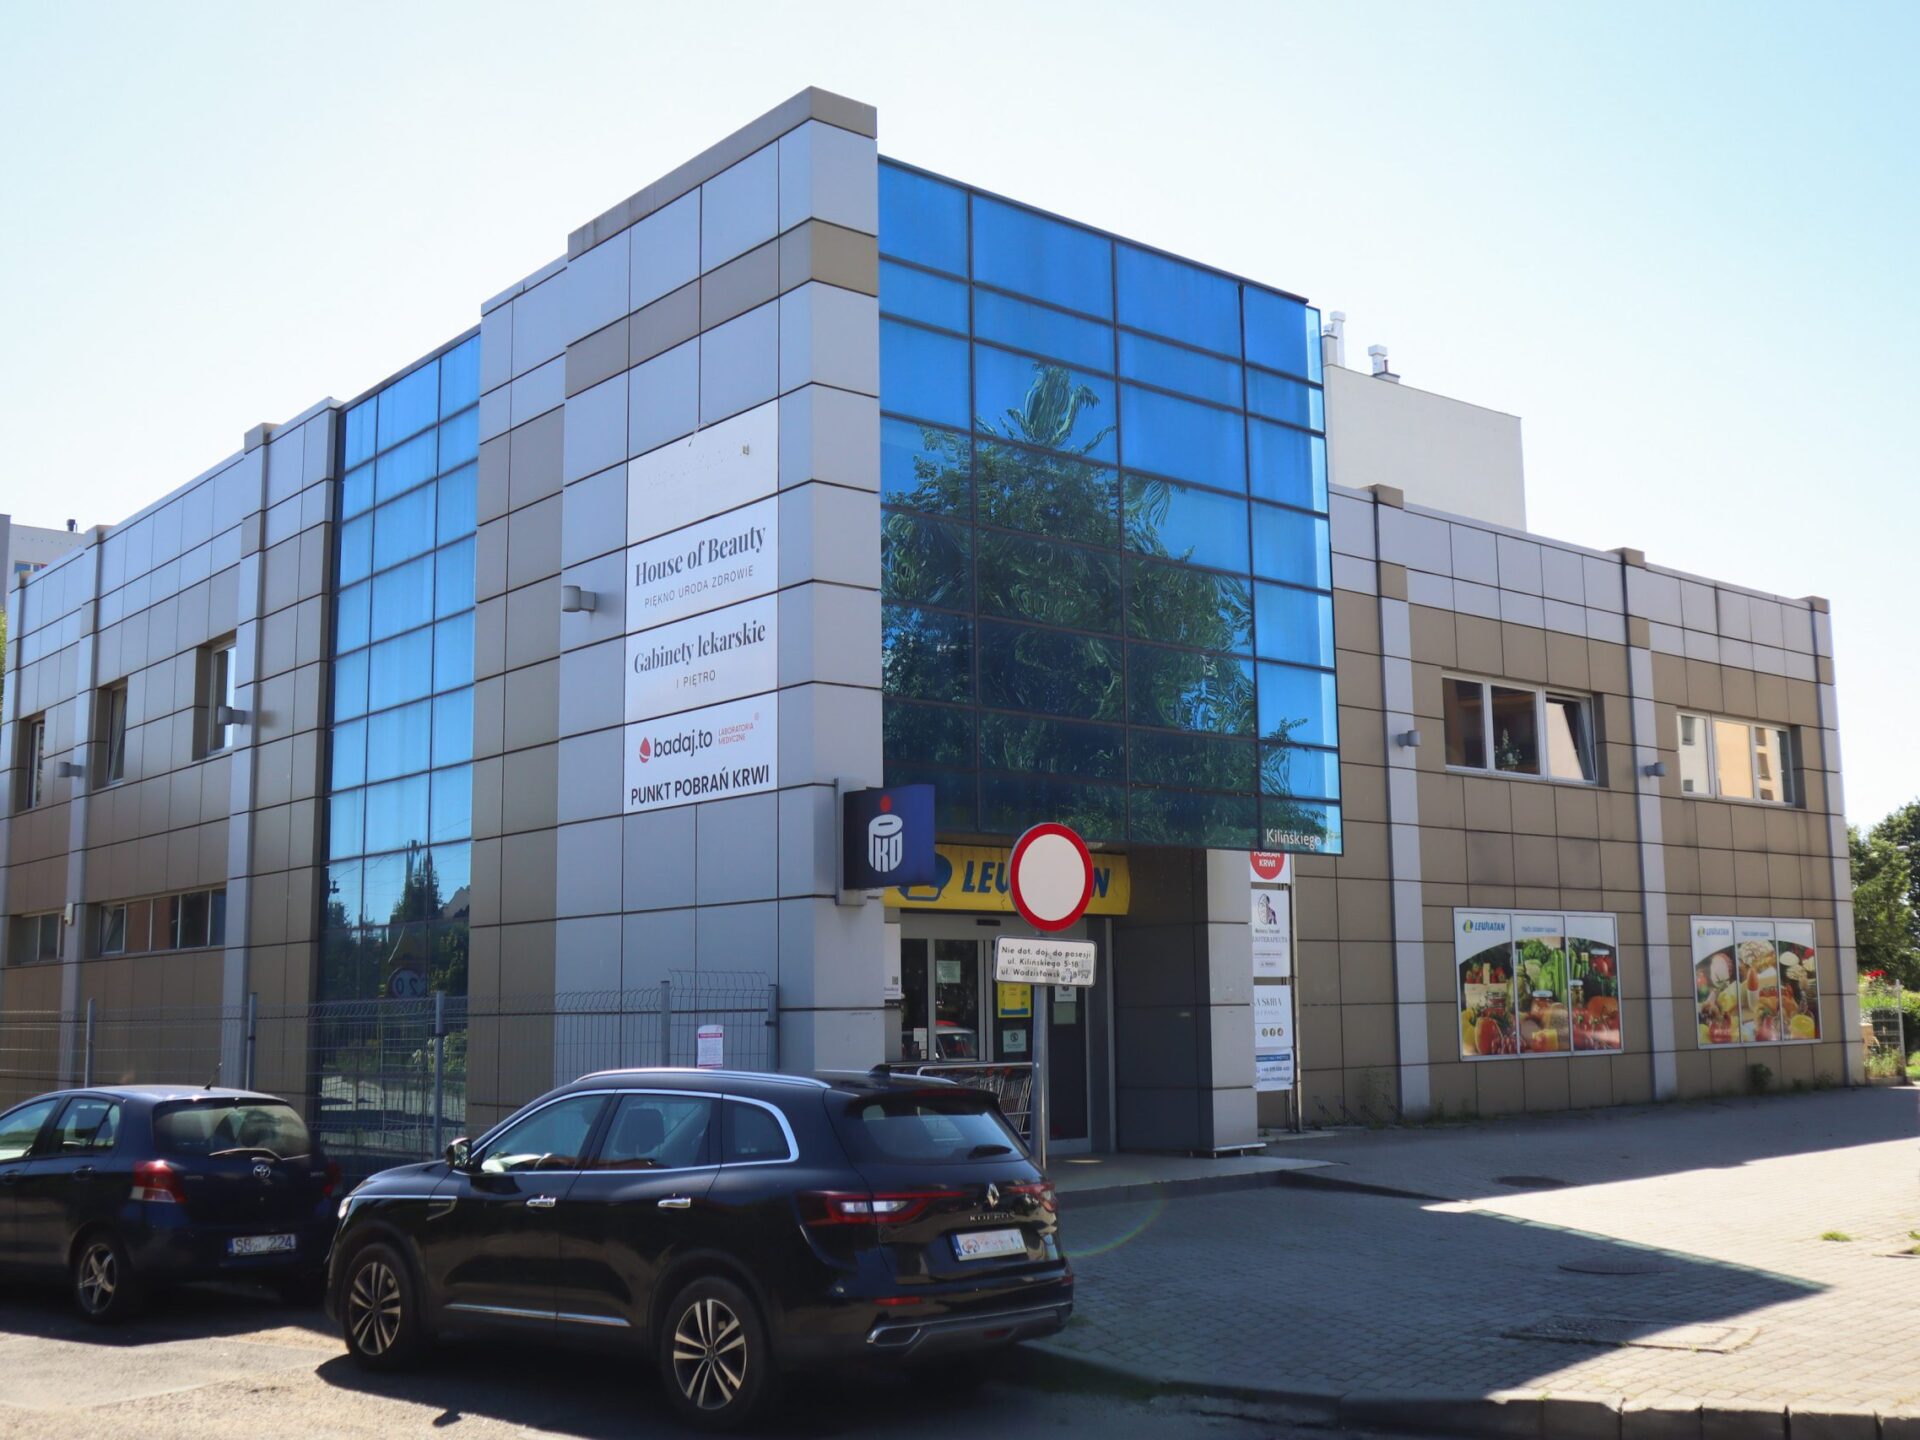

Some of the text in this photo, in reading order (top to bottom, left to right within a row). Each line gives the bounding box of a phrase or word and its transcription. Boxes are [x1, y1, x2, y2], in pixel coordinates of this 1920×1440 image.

[635, 526, 766, 587] House of Beauty
[644, 565, 754, 608] PIĘKNO URODA ZDROWIE
[634, 620, 766, 674] Gabinety lekarskie
[683, 670, 716, 688] PIĘTRO
[718, 722, 754, 736] LABORATORIA
[718, 733, 746, 745] MEDYCZNE
[654, 729, 713, 758] badaj.to
[631, 764, 769, 805] PUNKT POBRAŃ KRWI
[1266, 828, 1322, 850] Kilińskiego
[1259, 859, 1276, 868] KRWI
[1001, 946, 1015, 954] Nie
[1052, 949, 1063, 957] do
[1065, 950, 1091, 959] posesji
